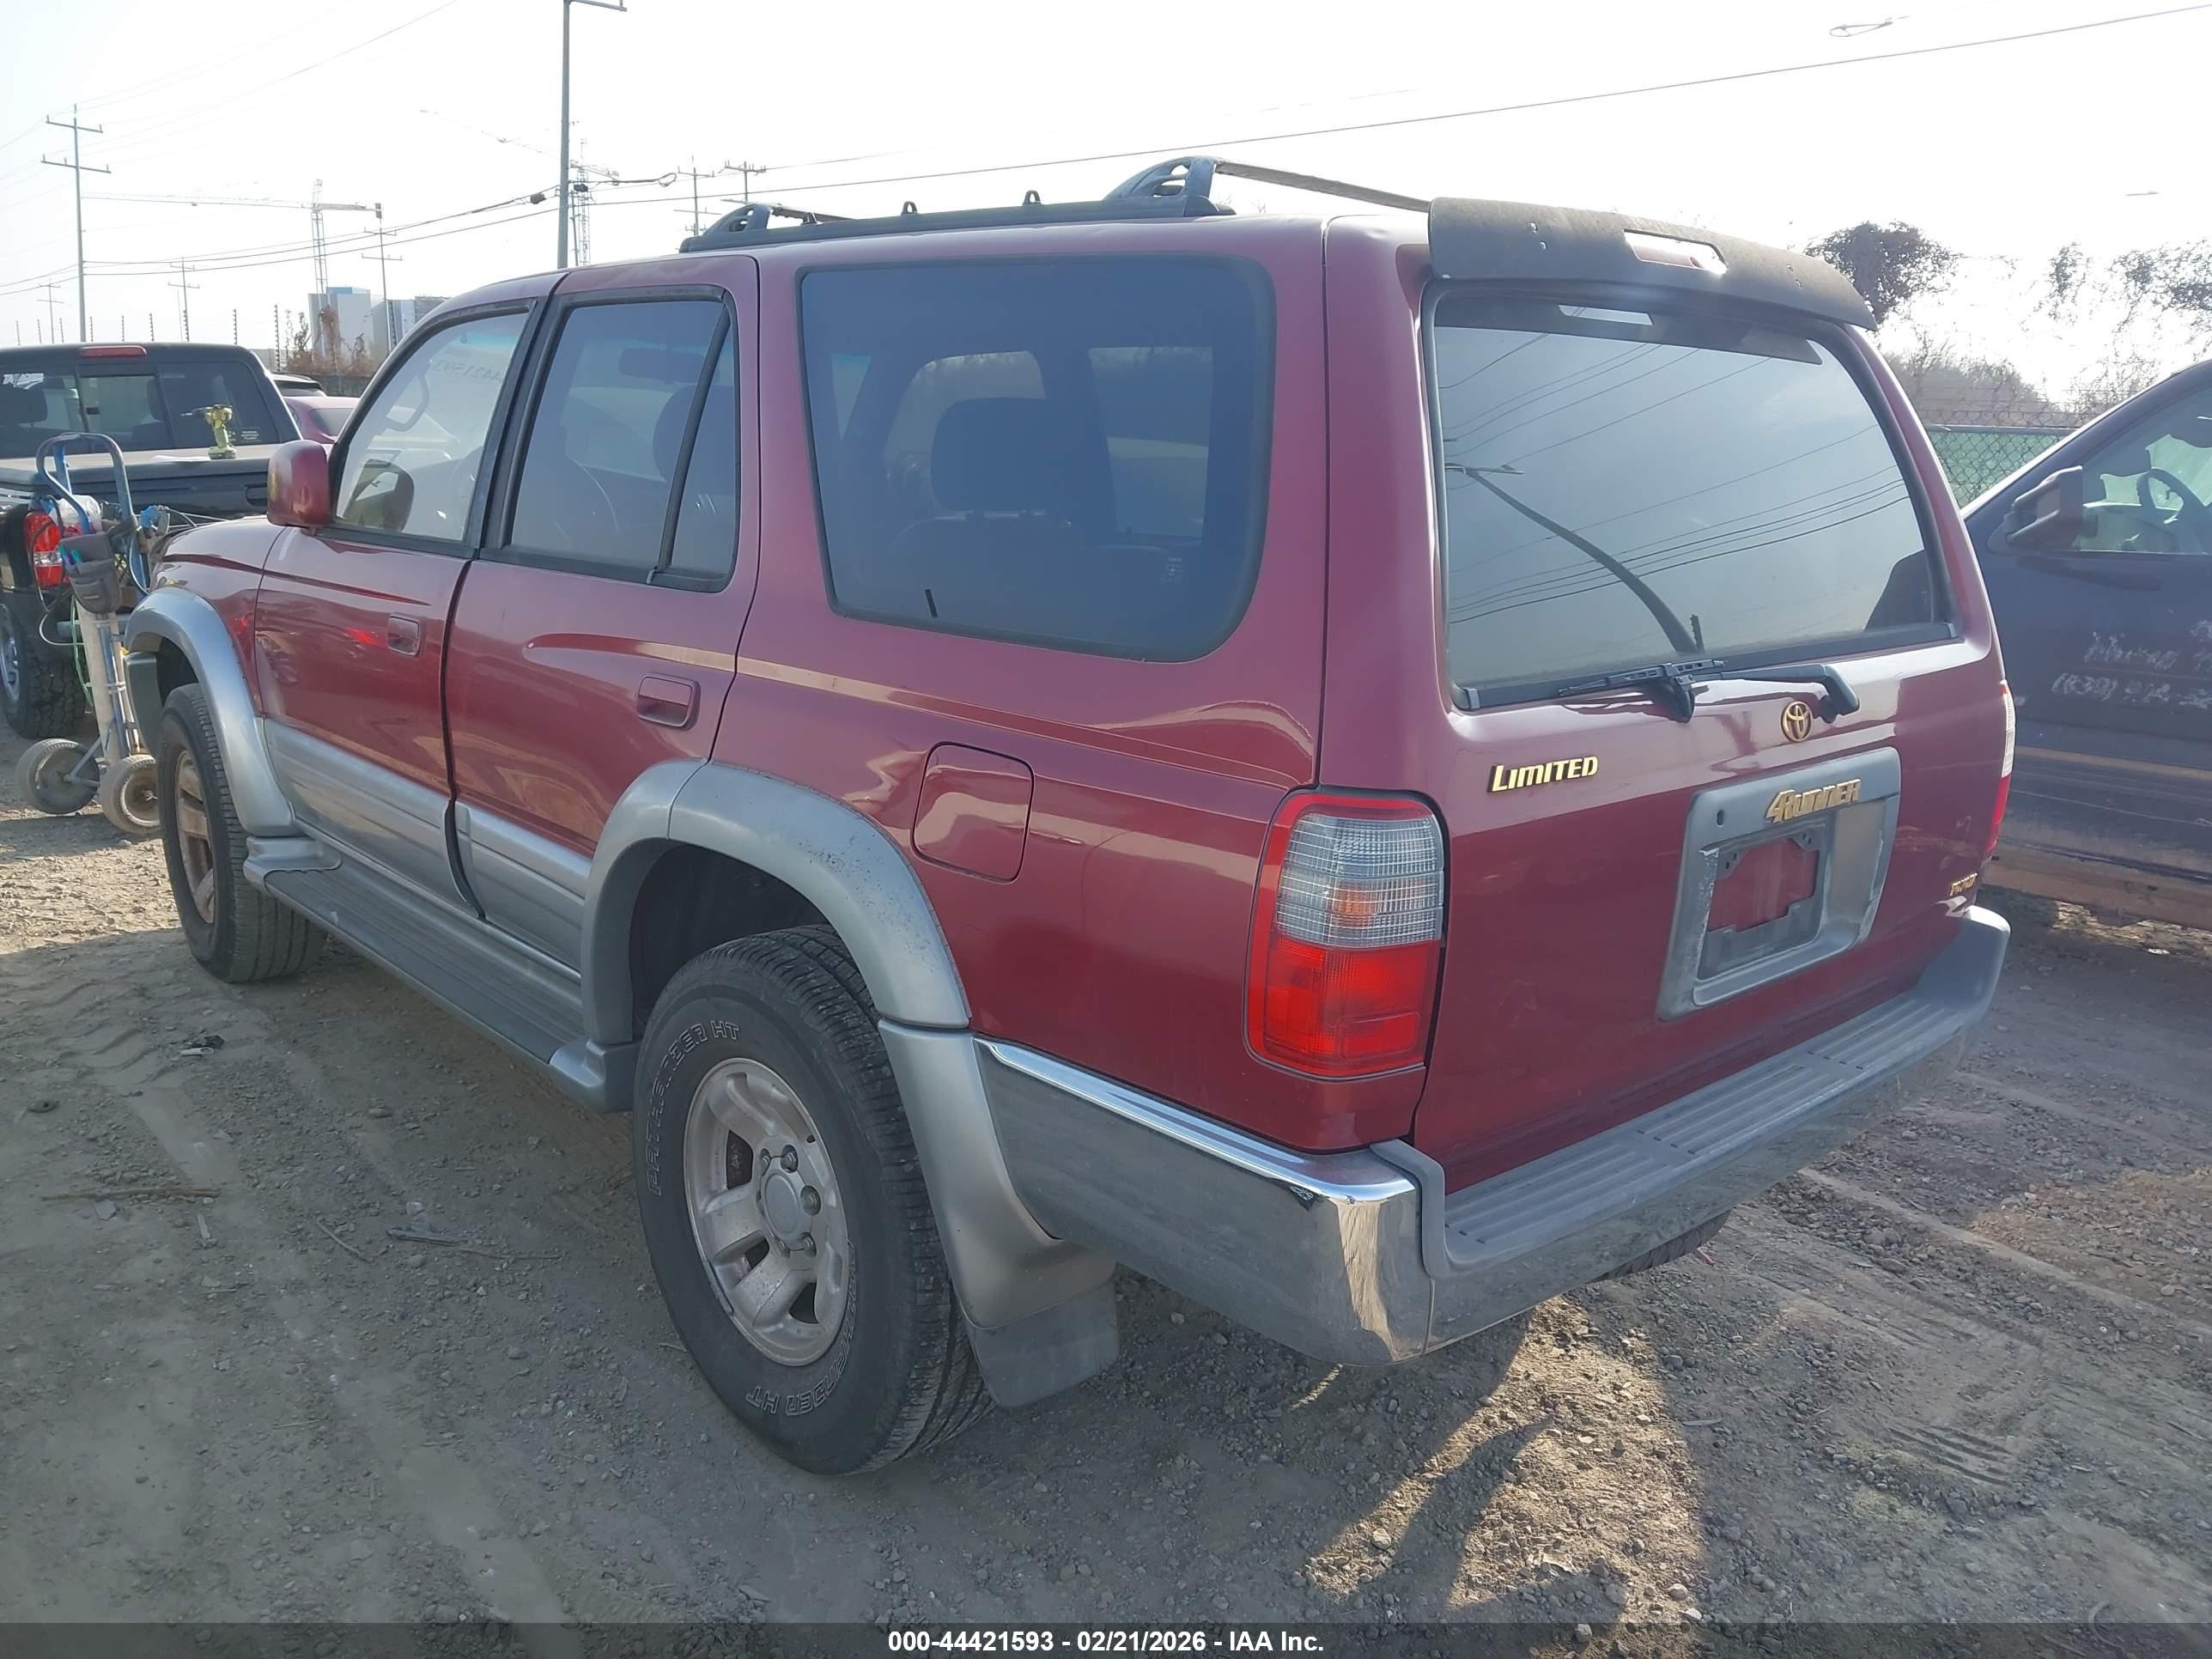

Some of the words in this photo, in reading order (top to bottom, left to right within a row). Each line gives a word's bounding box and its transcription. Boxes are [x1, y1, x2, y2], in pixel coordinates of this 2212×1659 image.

[1490, 756, 1599, 792] LIMITED
[1765, 778, 1863, 823] 4RUNNER
[710, 1019, 740, 1041] HT
[744, 1385, 780, 1414] HT
